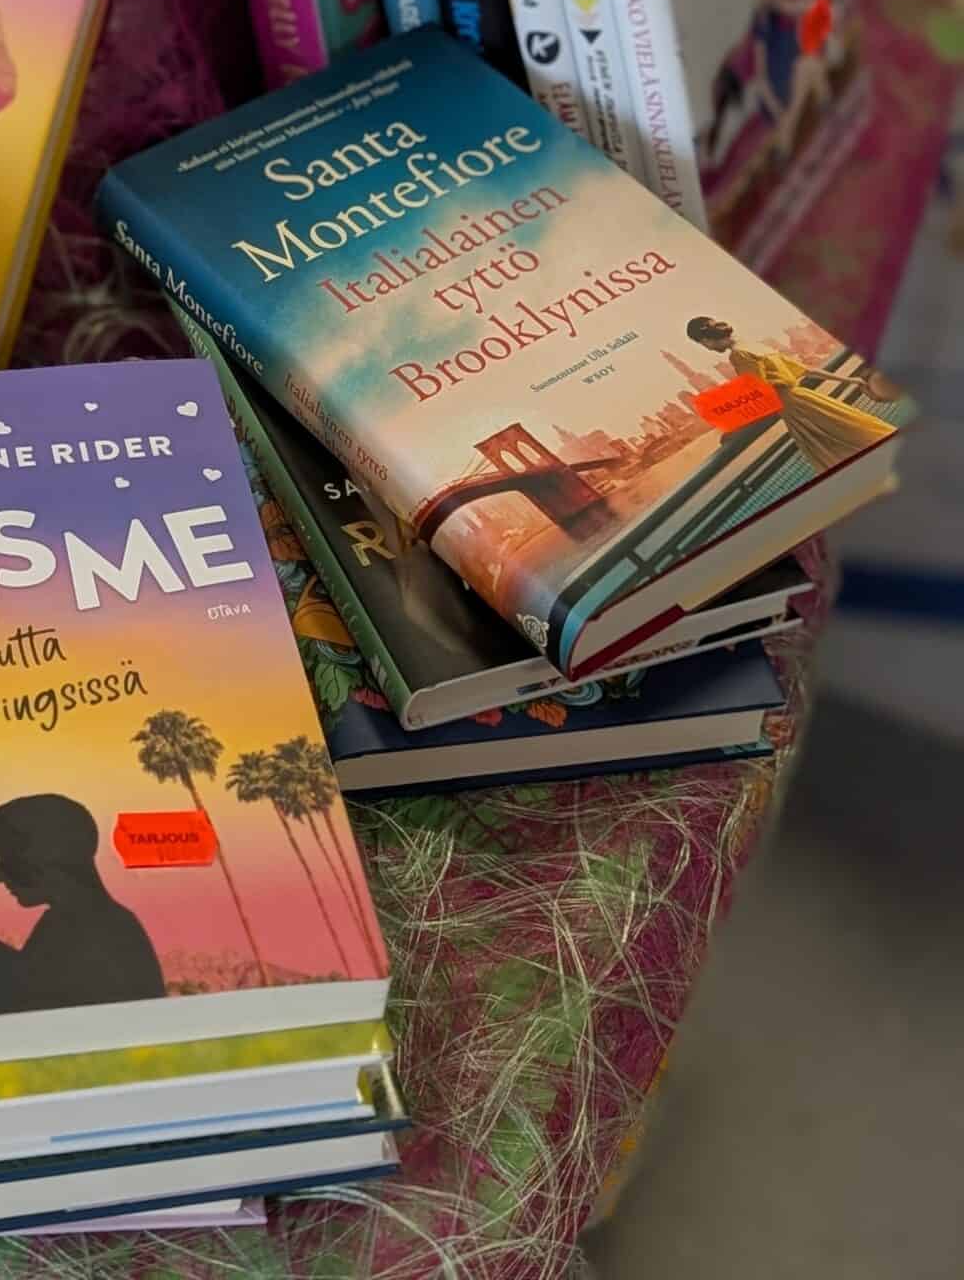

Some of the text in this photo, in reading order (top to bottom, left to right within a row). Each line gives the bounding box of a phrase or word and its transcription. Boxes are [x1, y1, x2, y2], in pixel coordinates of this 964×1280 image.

[262, 122, 428, 202] Santa
[231, 126, 542, 283] Montefiore
[315, 183, 571, 314] Italialainen
[433, 240, 541, 316] tyttö
[115, 220, 162, 280] Santa
[164, 268, 266, 377] Montefiore
[388, 243, 678, 404] Brooklynissa
[712, 389, 765, 416] TARJOUS
[51, 434, 174, 465] RIDER
[354, 444, 390, 482] tyttö
[128, 831, 200, 844] TARJOUS
